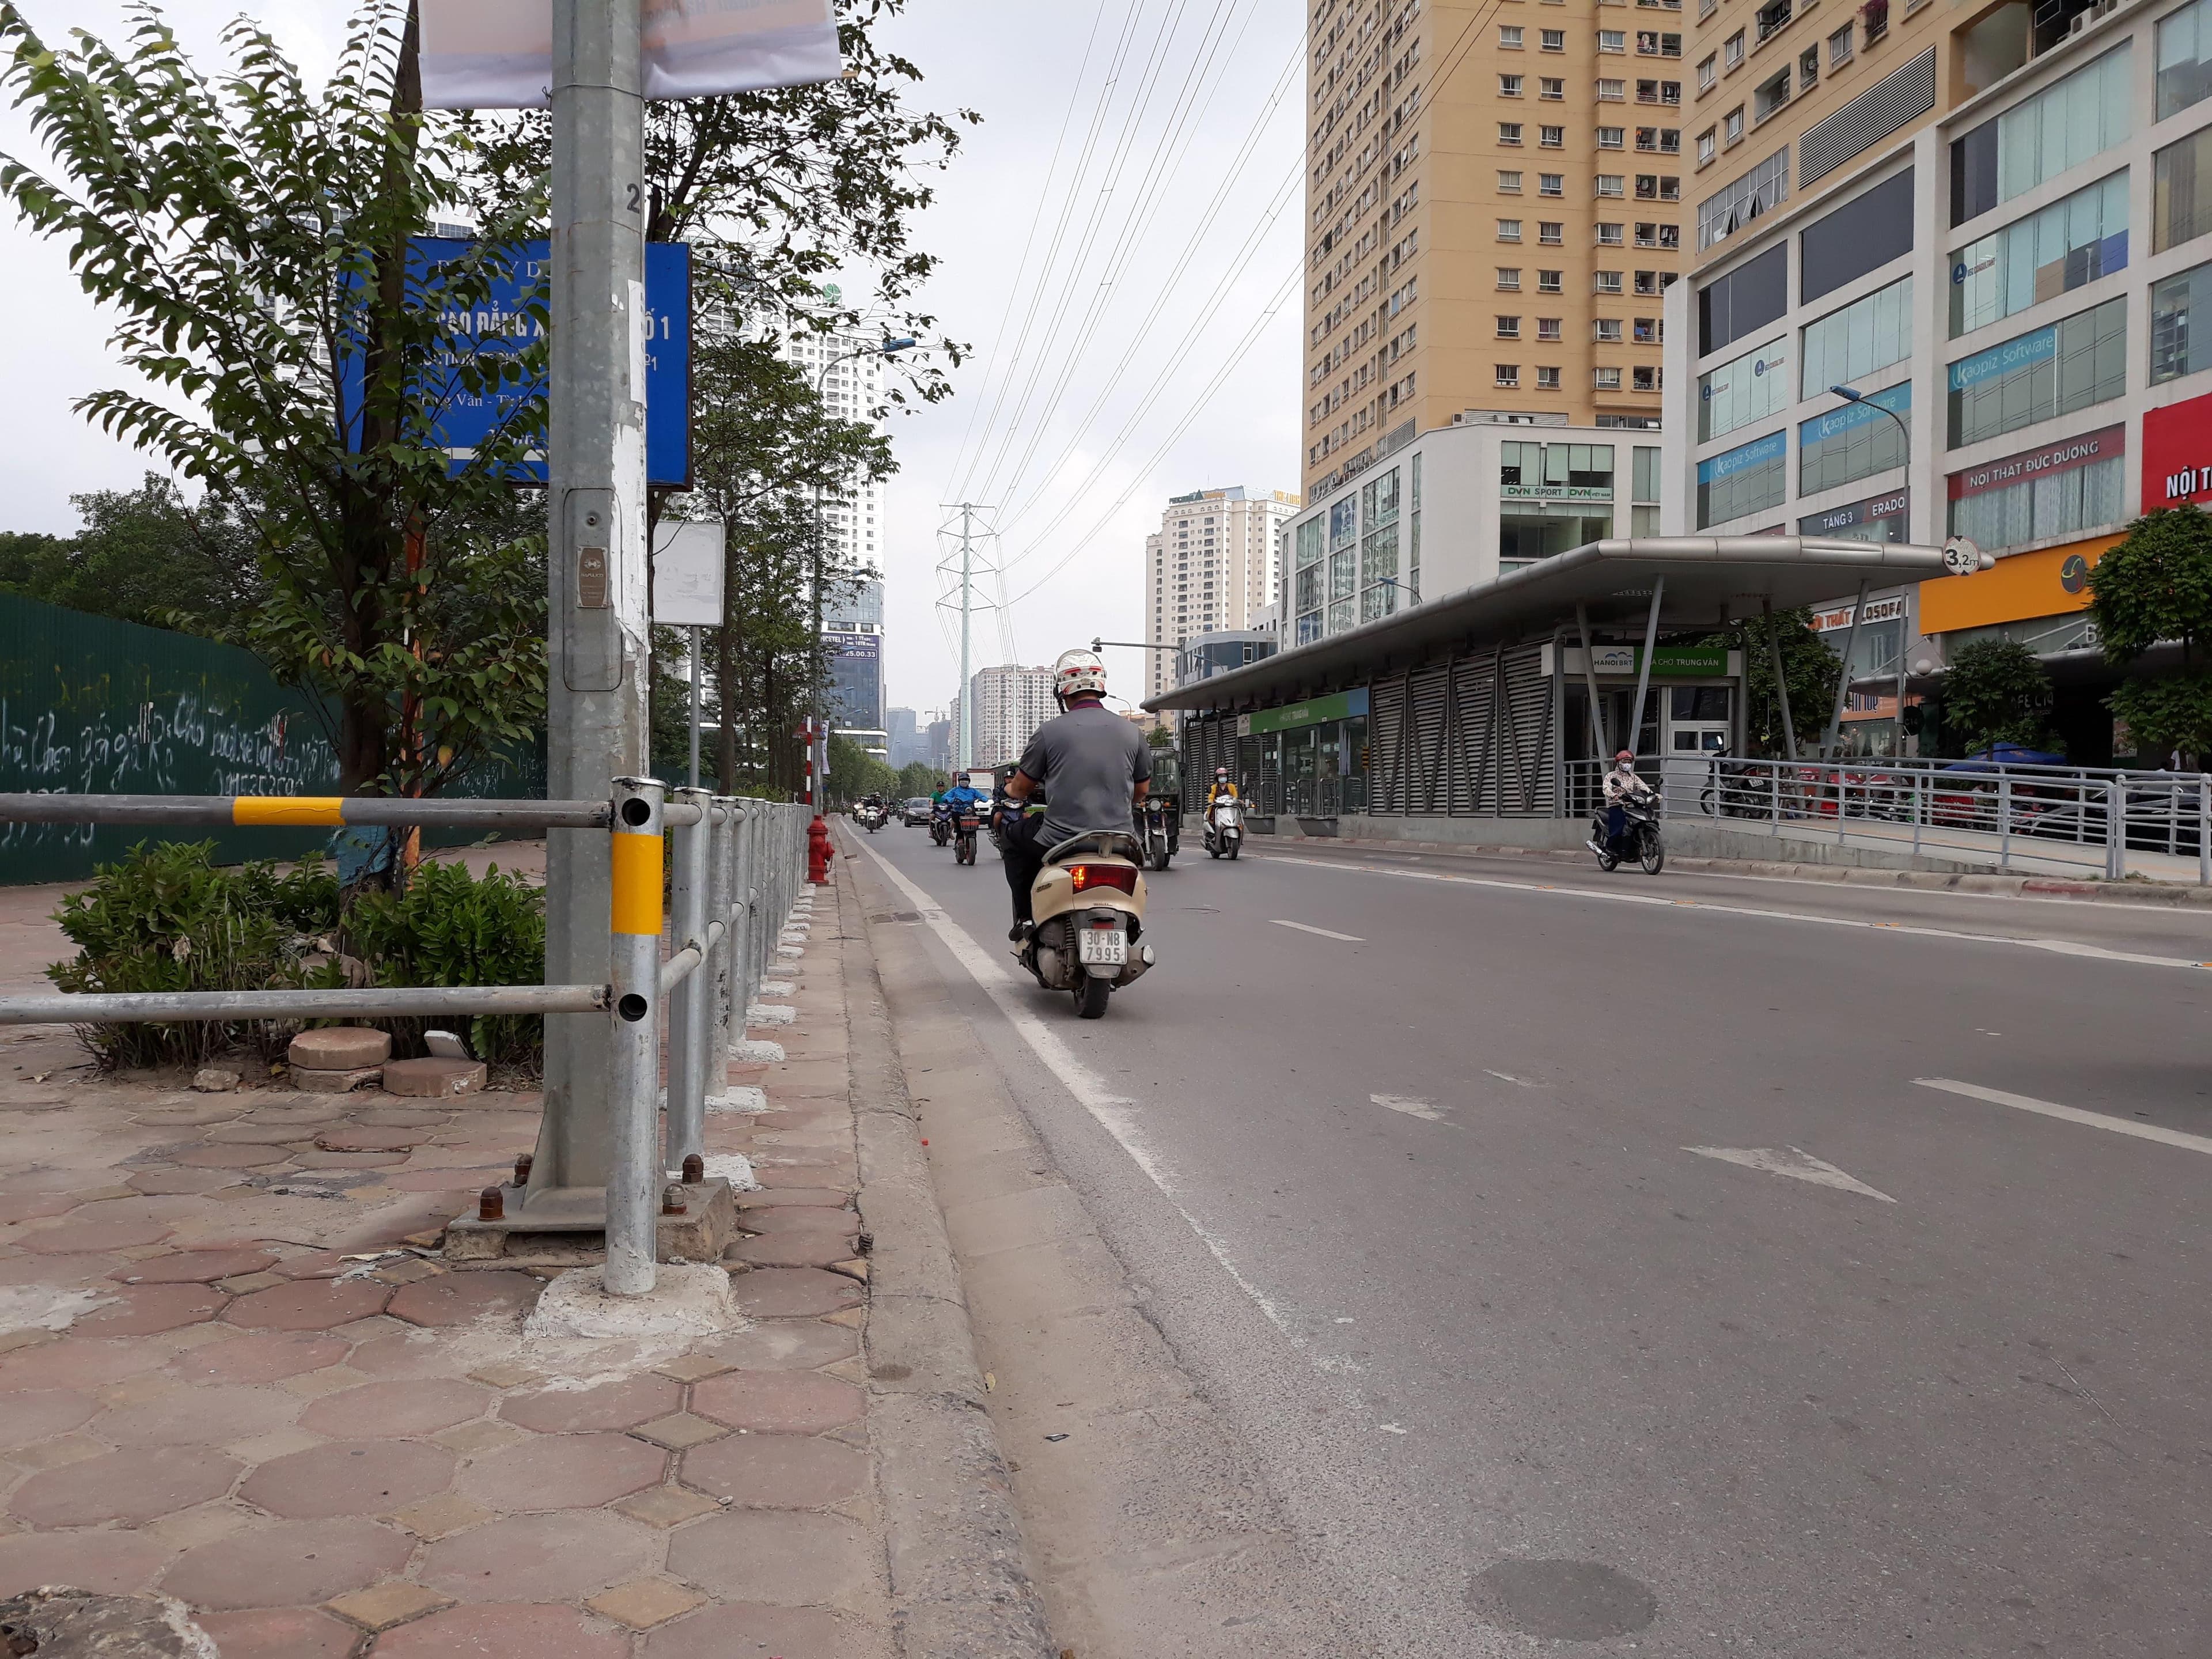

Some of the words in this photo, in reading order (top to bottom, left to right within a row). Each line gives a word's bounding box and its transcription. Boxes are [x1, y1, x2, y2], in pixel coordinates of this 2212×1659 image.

[626, 183, 640, 214] 2
[661, 316, 669, 340] 1
[1956, 356, 1998, 386] kaopiz
[2002, 335, 2054, 365] Software
[456, 393, 483, 407] Văn
[1821, 410, 1854, 436] kaopiz
[1716, 453, 1743, 476] kaopiz
[1745, 441, 1777, 461] Software
[1508, 487, 1531, 495] DVN
[1535, 488, 1563, 497] SPORT
[1569, 488, 1591, 497] DVN
[2166, 465, 2197, 501] NỘI
[2201, 465, 2212, 491] T
[1847, 511, 1853, 524] 3
[1872, 496, 1905, 517] ERADO
[1086, 946, 1120, 962] 7995
